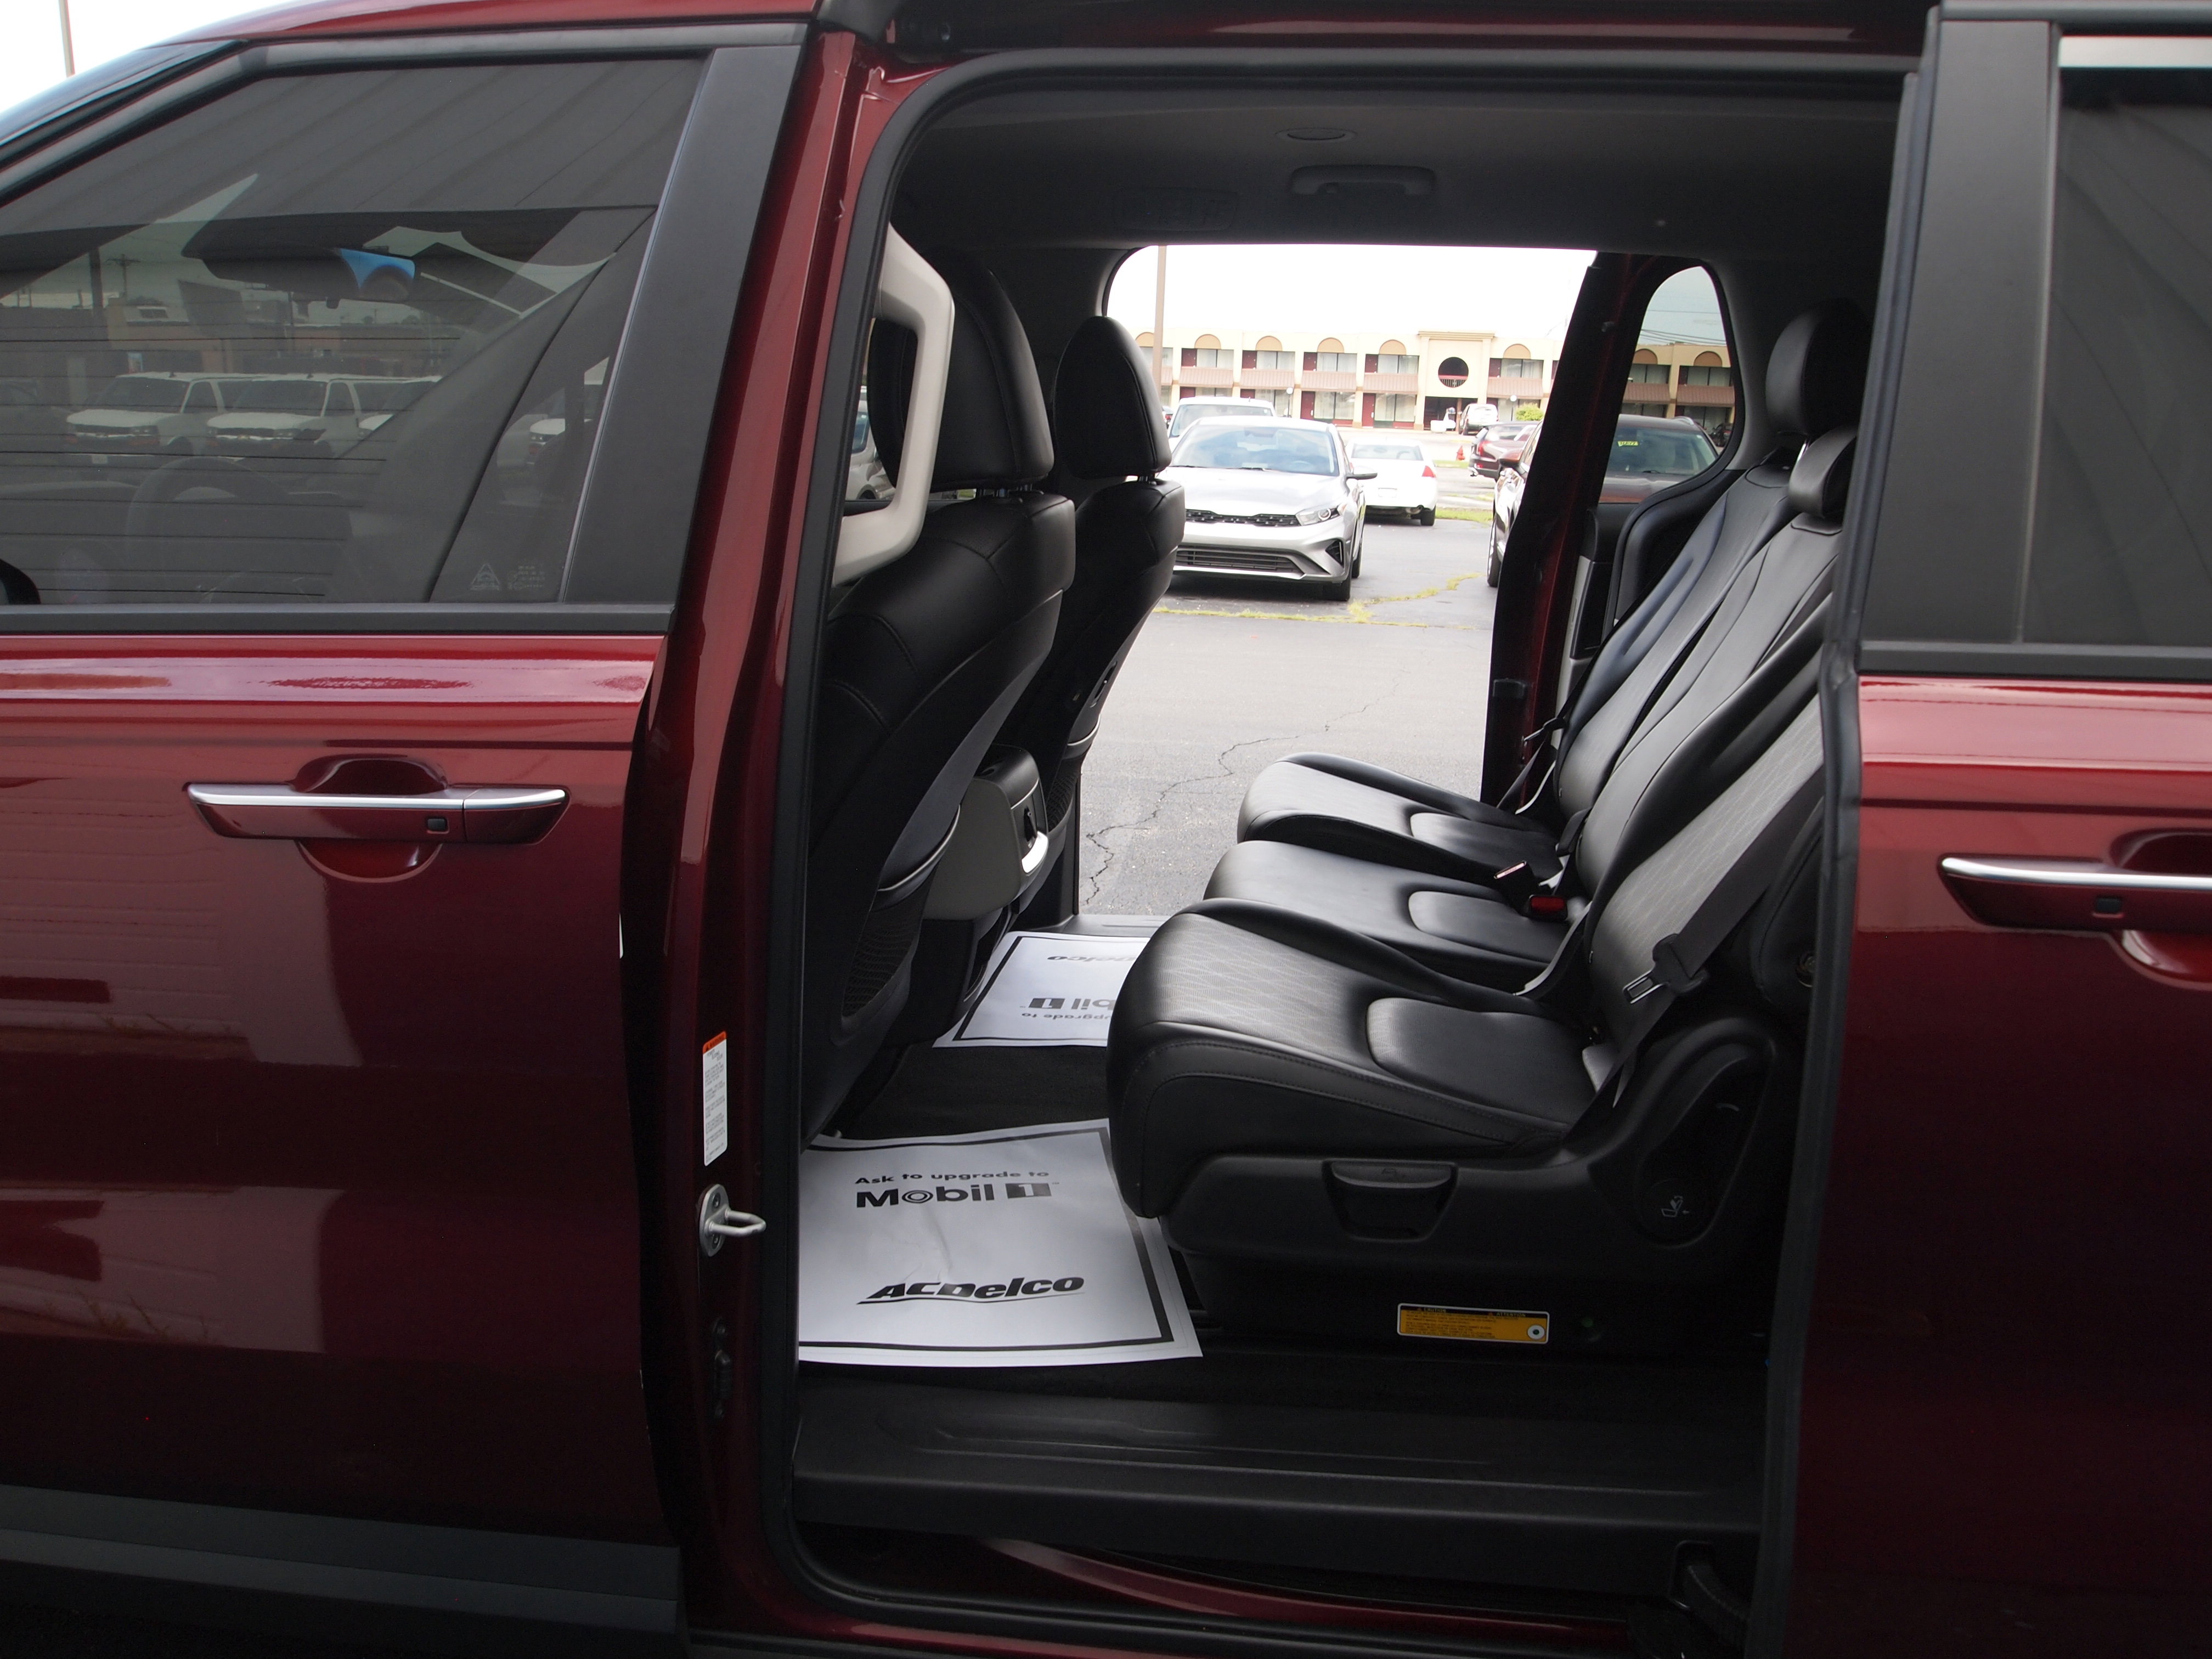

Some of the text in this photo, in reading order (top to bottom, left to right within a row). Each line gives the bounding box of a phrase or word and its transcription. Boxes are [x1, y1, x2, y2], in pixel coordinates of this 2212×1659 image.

[1071, 998, 1118, 1011] bil
[855, 1175, 895, 1184] Ask
[931, 1171, 1022, 1181] upgrade
[856, 1183, 995, 1208] Mobil
[866, 1277, 1085, 1300] ACDelco
